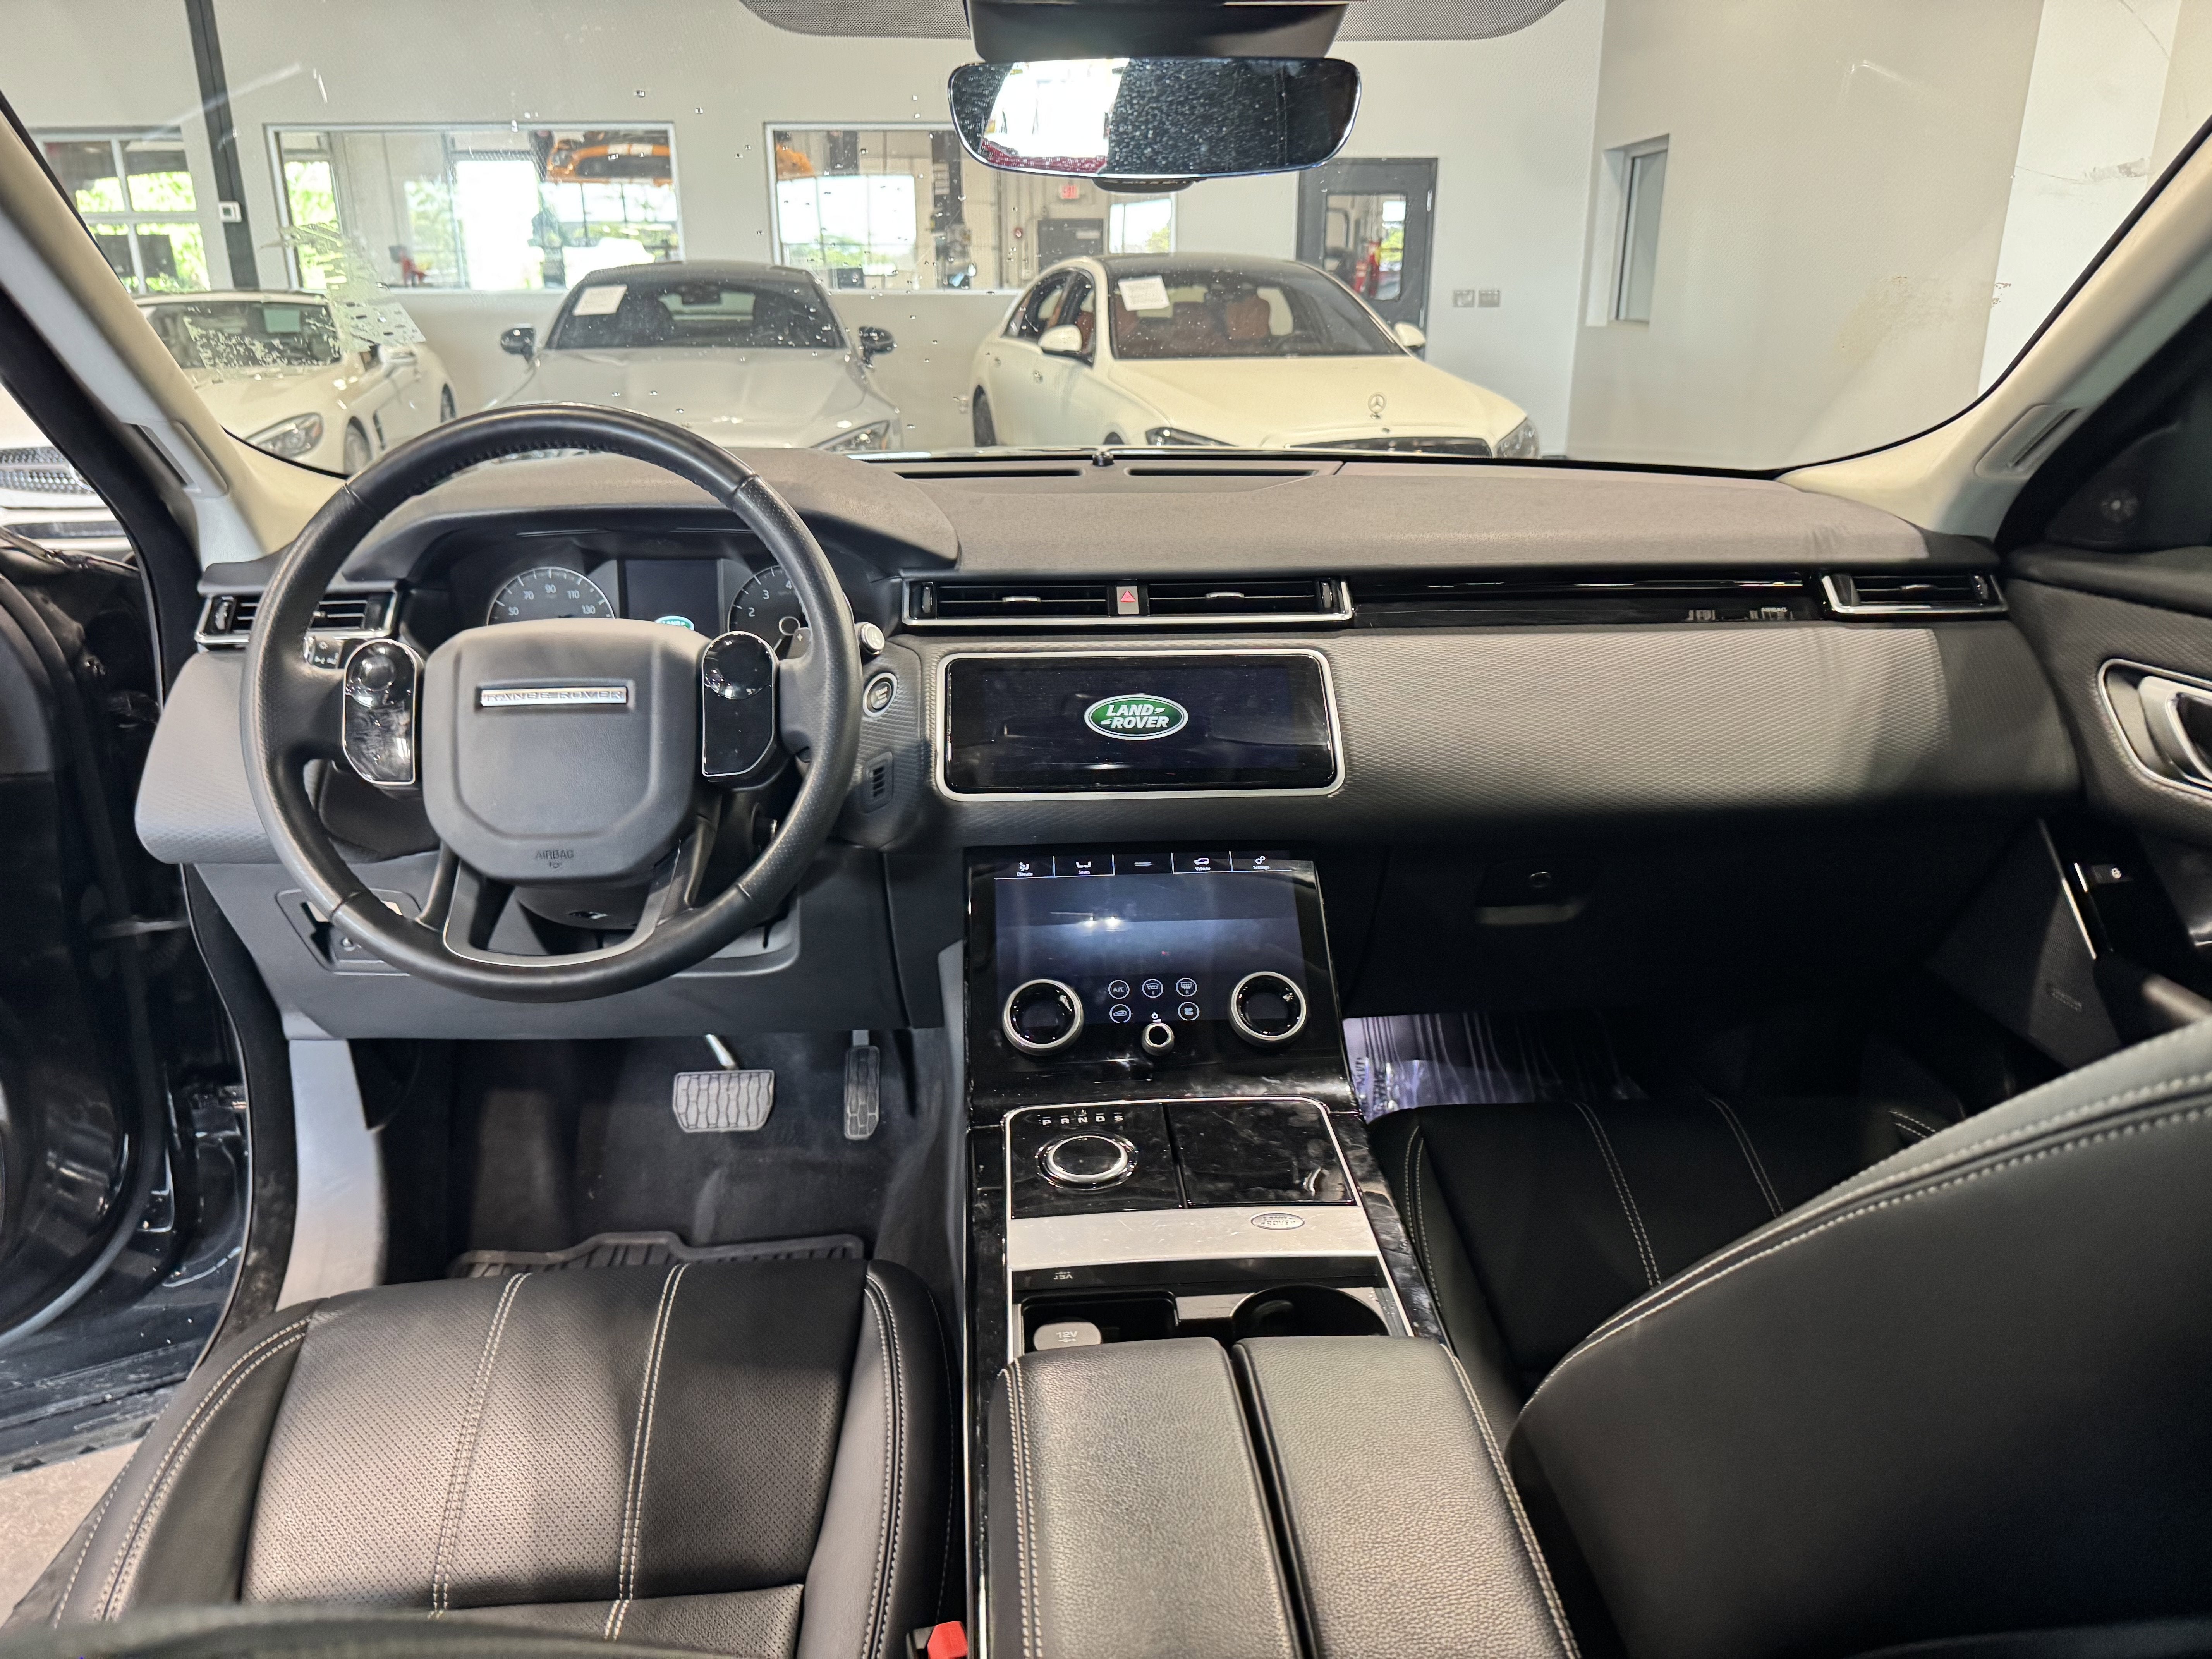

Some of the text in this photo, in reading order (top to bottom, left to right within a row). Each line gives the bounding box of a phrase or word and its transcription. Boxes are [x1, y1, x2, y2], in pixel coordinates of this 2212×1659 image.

[544, 584, 556, 593] 90
[785, 580, 792, 589] 4
[524, 591, 534, 600] 70
[567, 590, 580, 599] 110
[763, 589, 769, 599] 3
[582, 605, 596, 614] 130
[749, 607, 755, 617] 2
[1106, 704, 1154, 716] LAND
[1110, 716, 1169, 728] ROVER
[536, 850, 574, 859] AIRBAG
